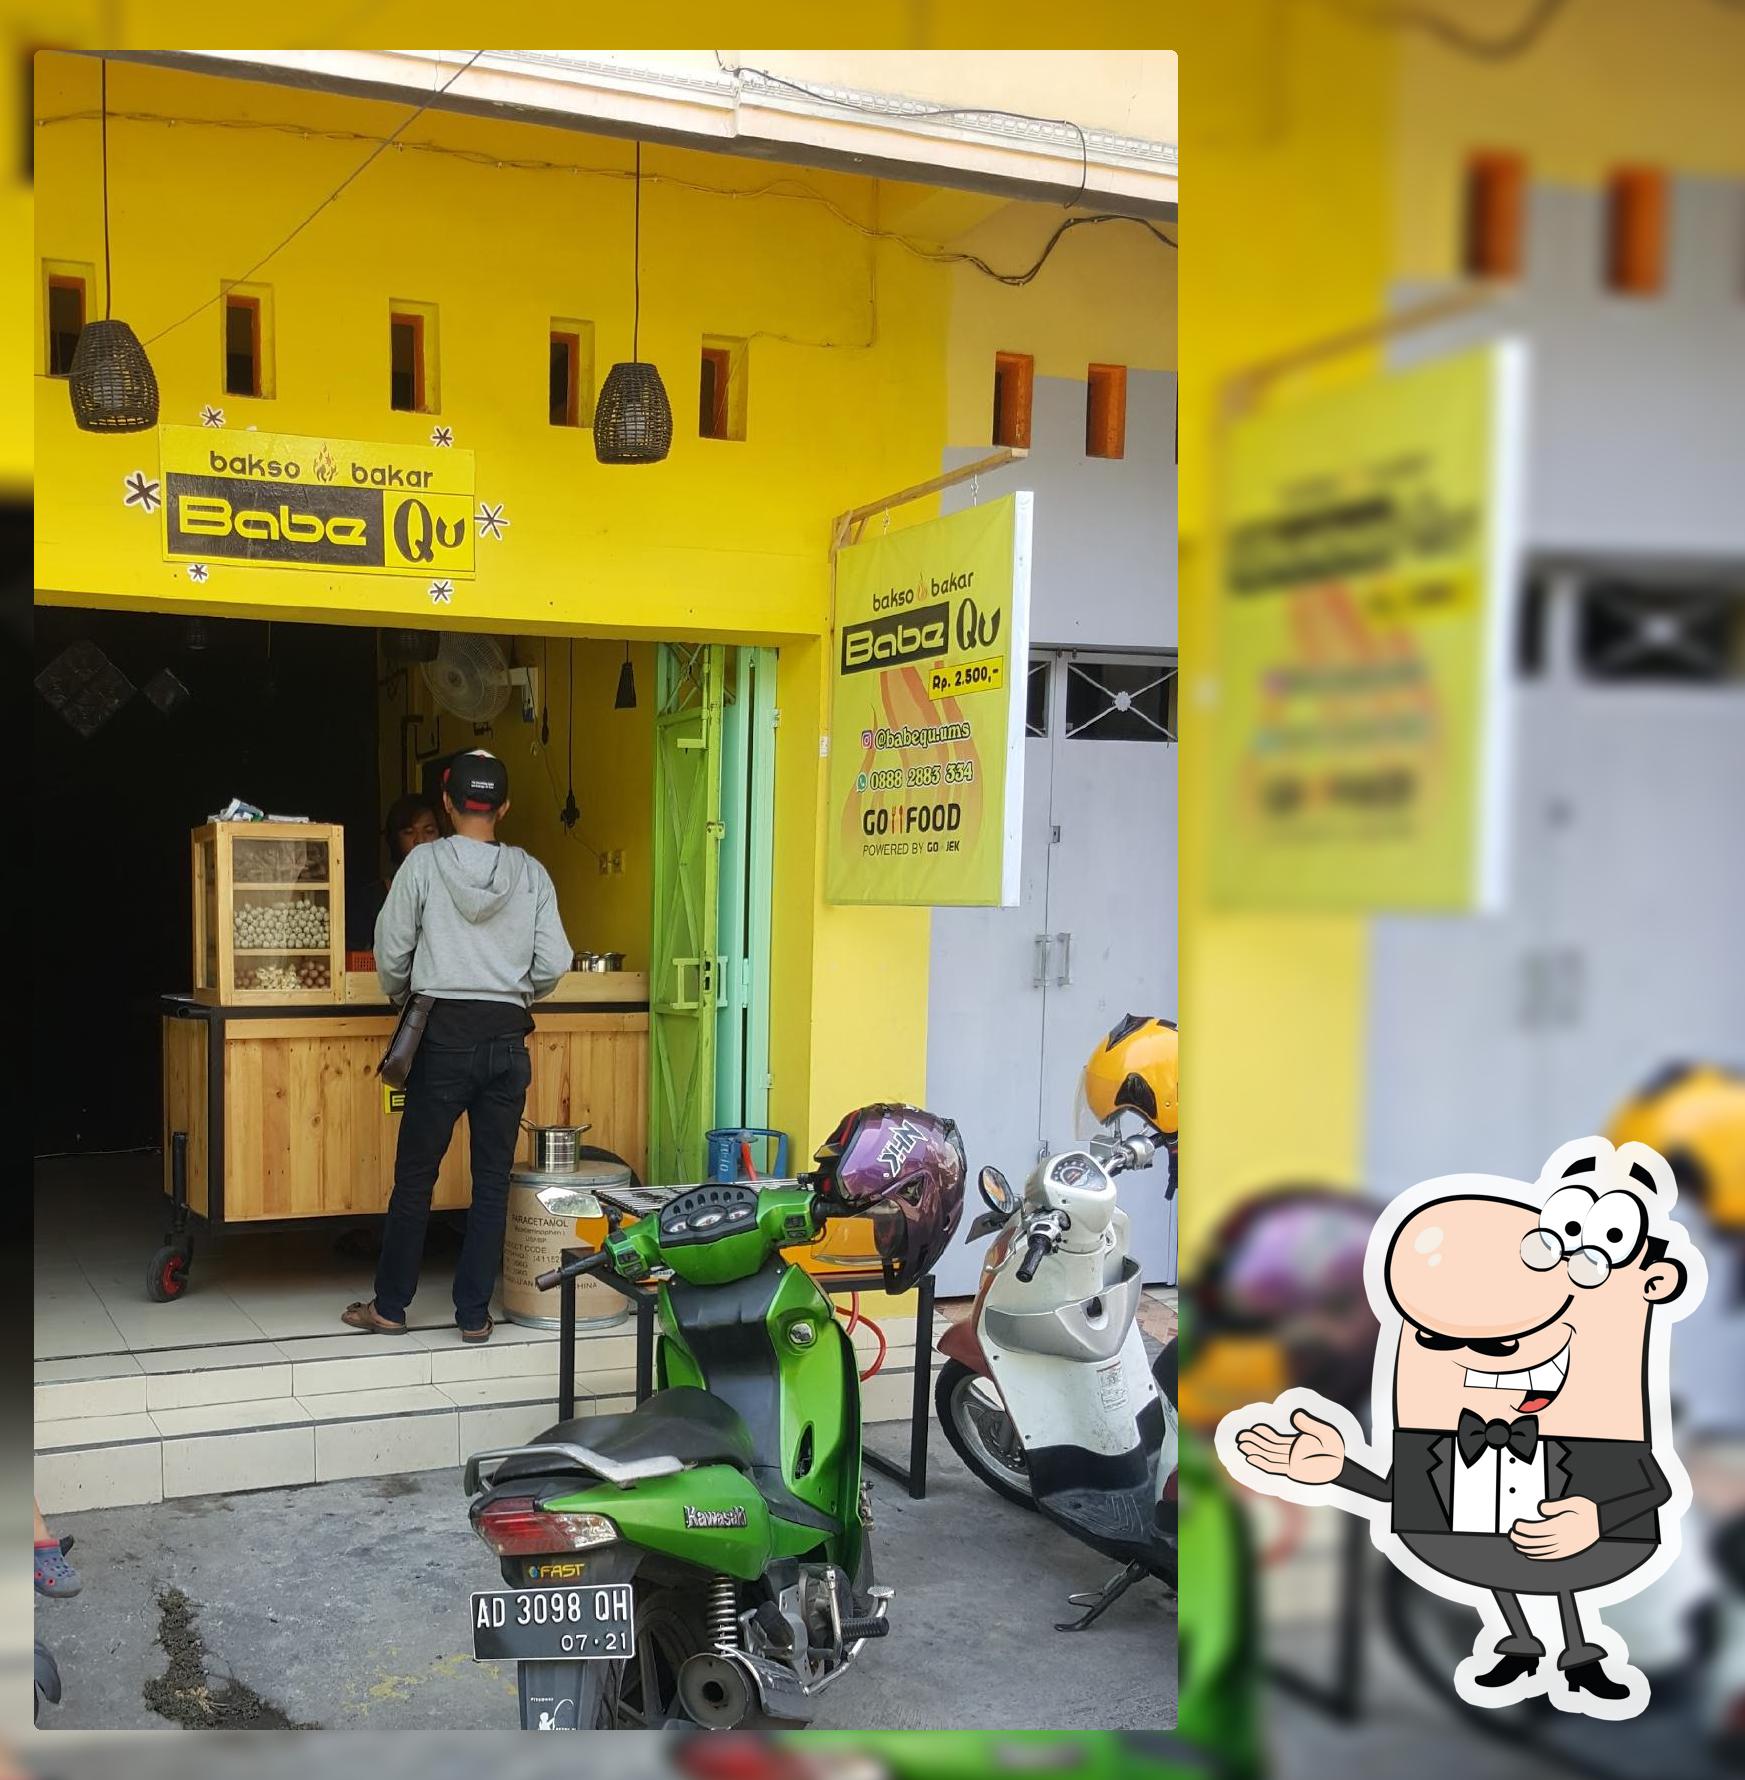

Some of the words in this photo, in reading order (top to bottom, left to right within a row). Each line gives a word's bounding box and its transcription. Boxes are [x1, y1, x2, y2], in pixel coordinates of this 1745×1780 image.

[210, 450, 301, 479] bakso
[351, 463, 434, 488] bakar
[178, 495, 367, 546] Babe
[393, 498, 466, 563] Qu
[872, 588, 915, 612] bakso
[931, 572, 974, 597] bakar
[845, 621, 945, 667] Babe
[956, 598, 1000, 651] Qu
[932, 675, 951, 691] Rp.
[954, 667, 999, 687] 2.500,-
[874, 722, 971, 749] @babequ.ums
[869, 770, 902, 790] 0888
[907, 766, 941, 786] 2883
[945, 761, 973, 783] 334
[863, 809, 888, 835] GO
[906, 803, 961, 833] FOOD
[862, 842, 909, 856] POWERED
[911, 842, 924, 855] BY
[877, 1119, 928, 1177] NHK
[684, 1505, 748, 1528] Kawasaki
[538, 1564, 585, 1578] FAST
[476, 1598, 506, 1629] AD
[516, 1592, 581, 1625] 3098
